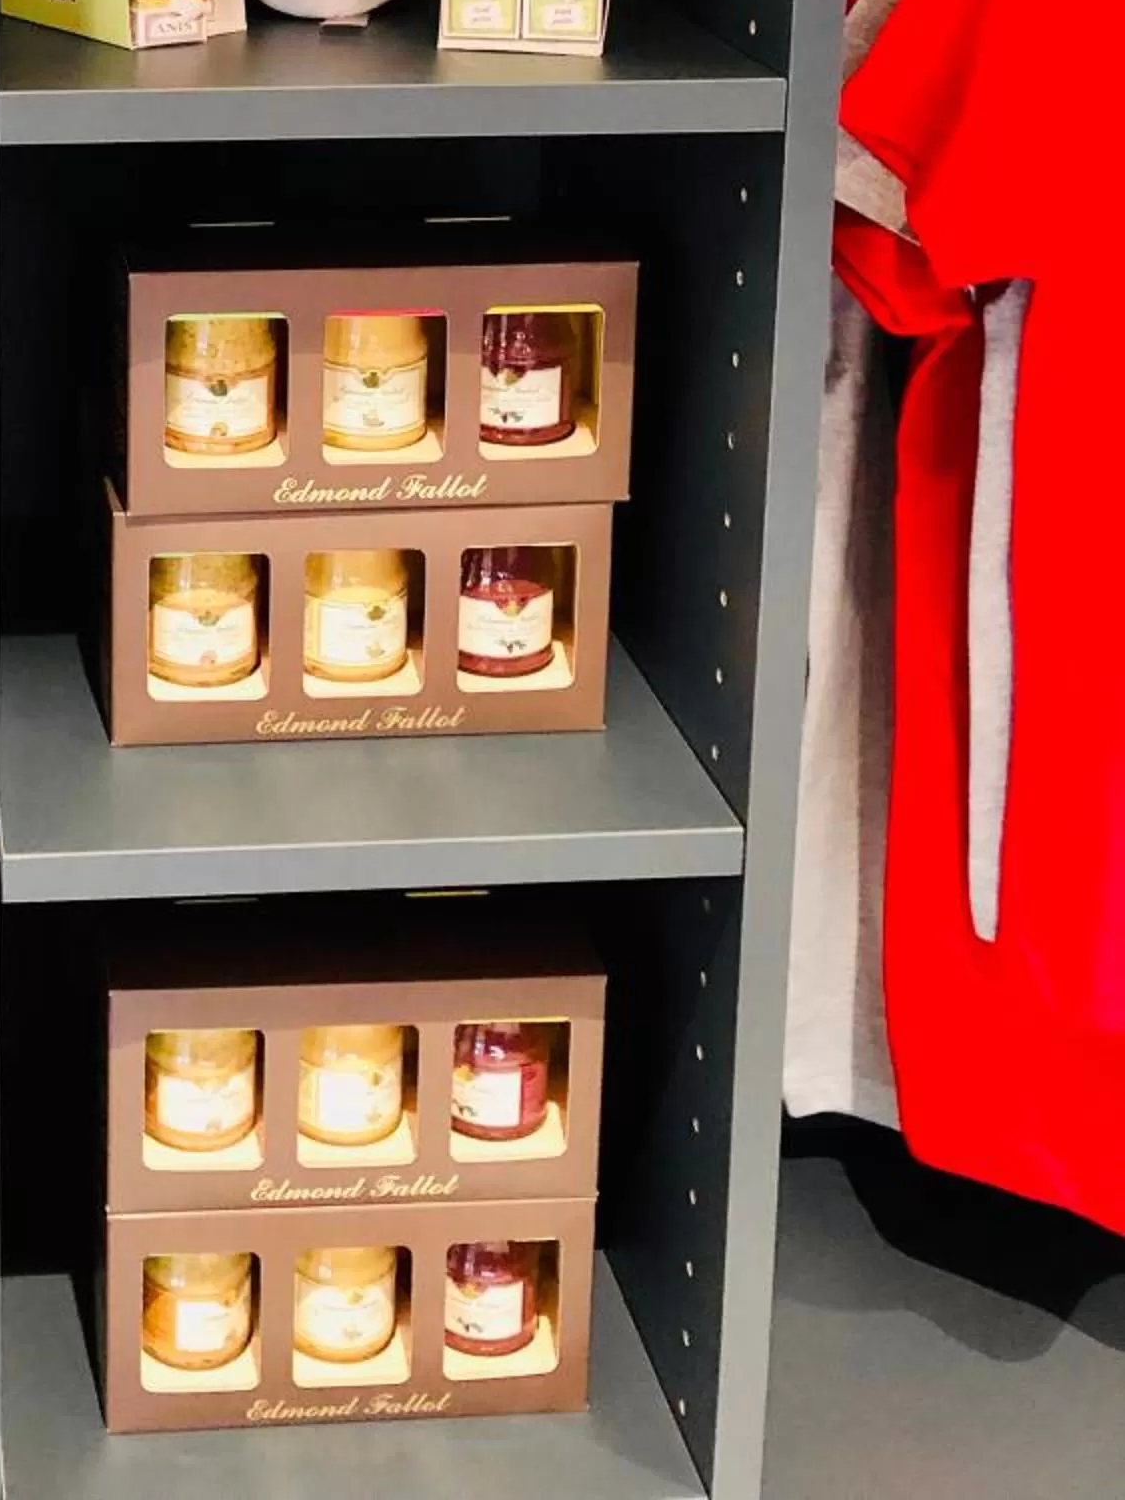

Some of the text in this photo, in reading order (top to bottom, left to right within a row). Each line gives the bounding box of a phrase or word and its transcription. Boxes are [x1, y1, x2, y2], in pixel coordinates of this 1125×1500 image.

[273, 473, 488, 503] Edmond Fallot
[255, 705, 468, 735] Edmond Fallot
[251, 1173, 460, 1202] Edmond Fallot
[246, 1392, 452, 1422] Edmond Fallot
